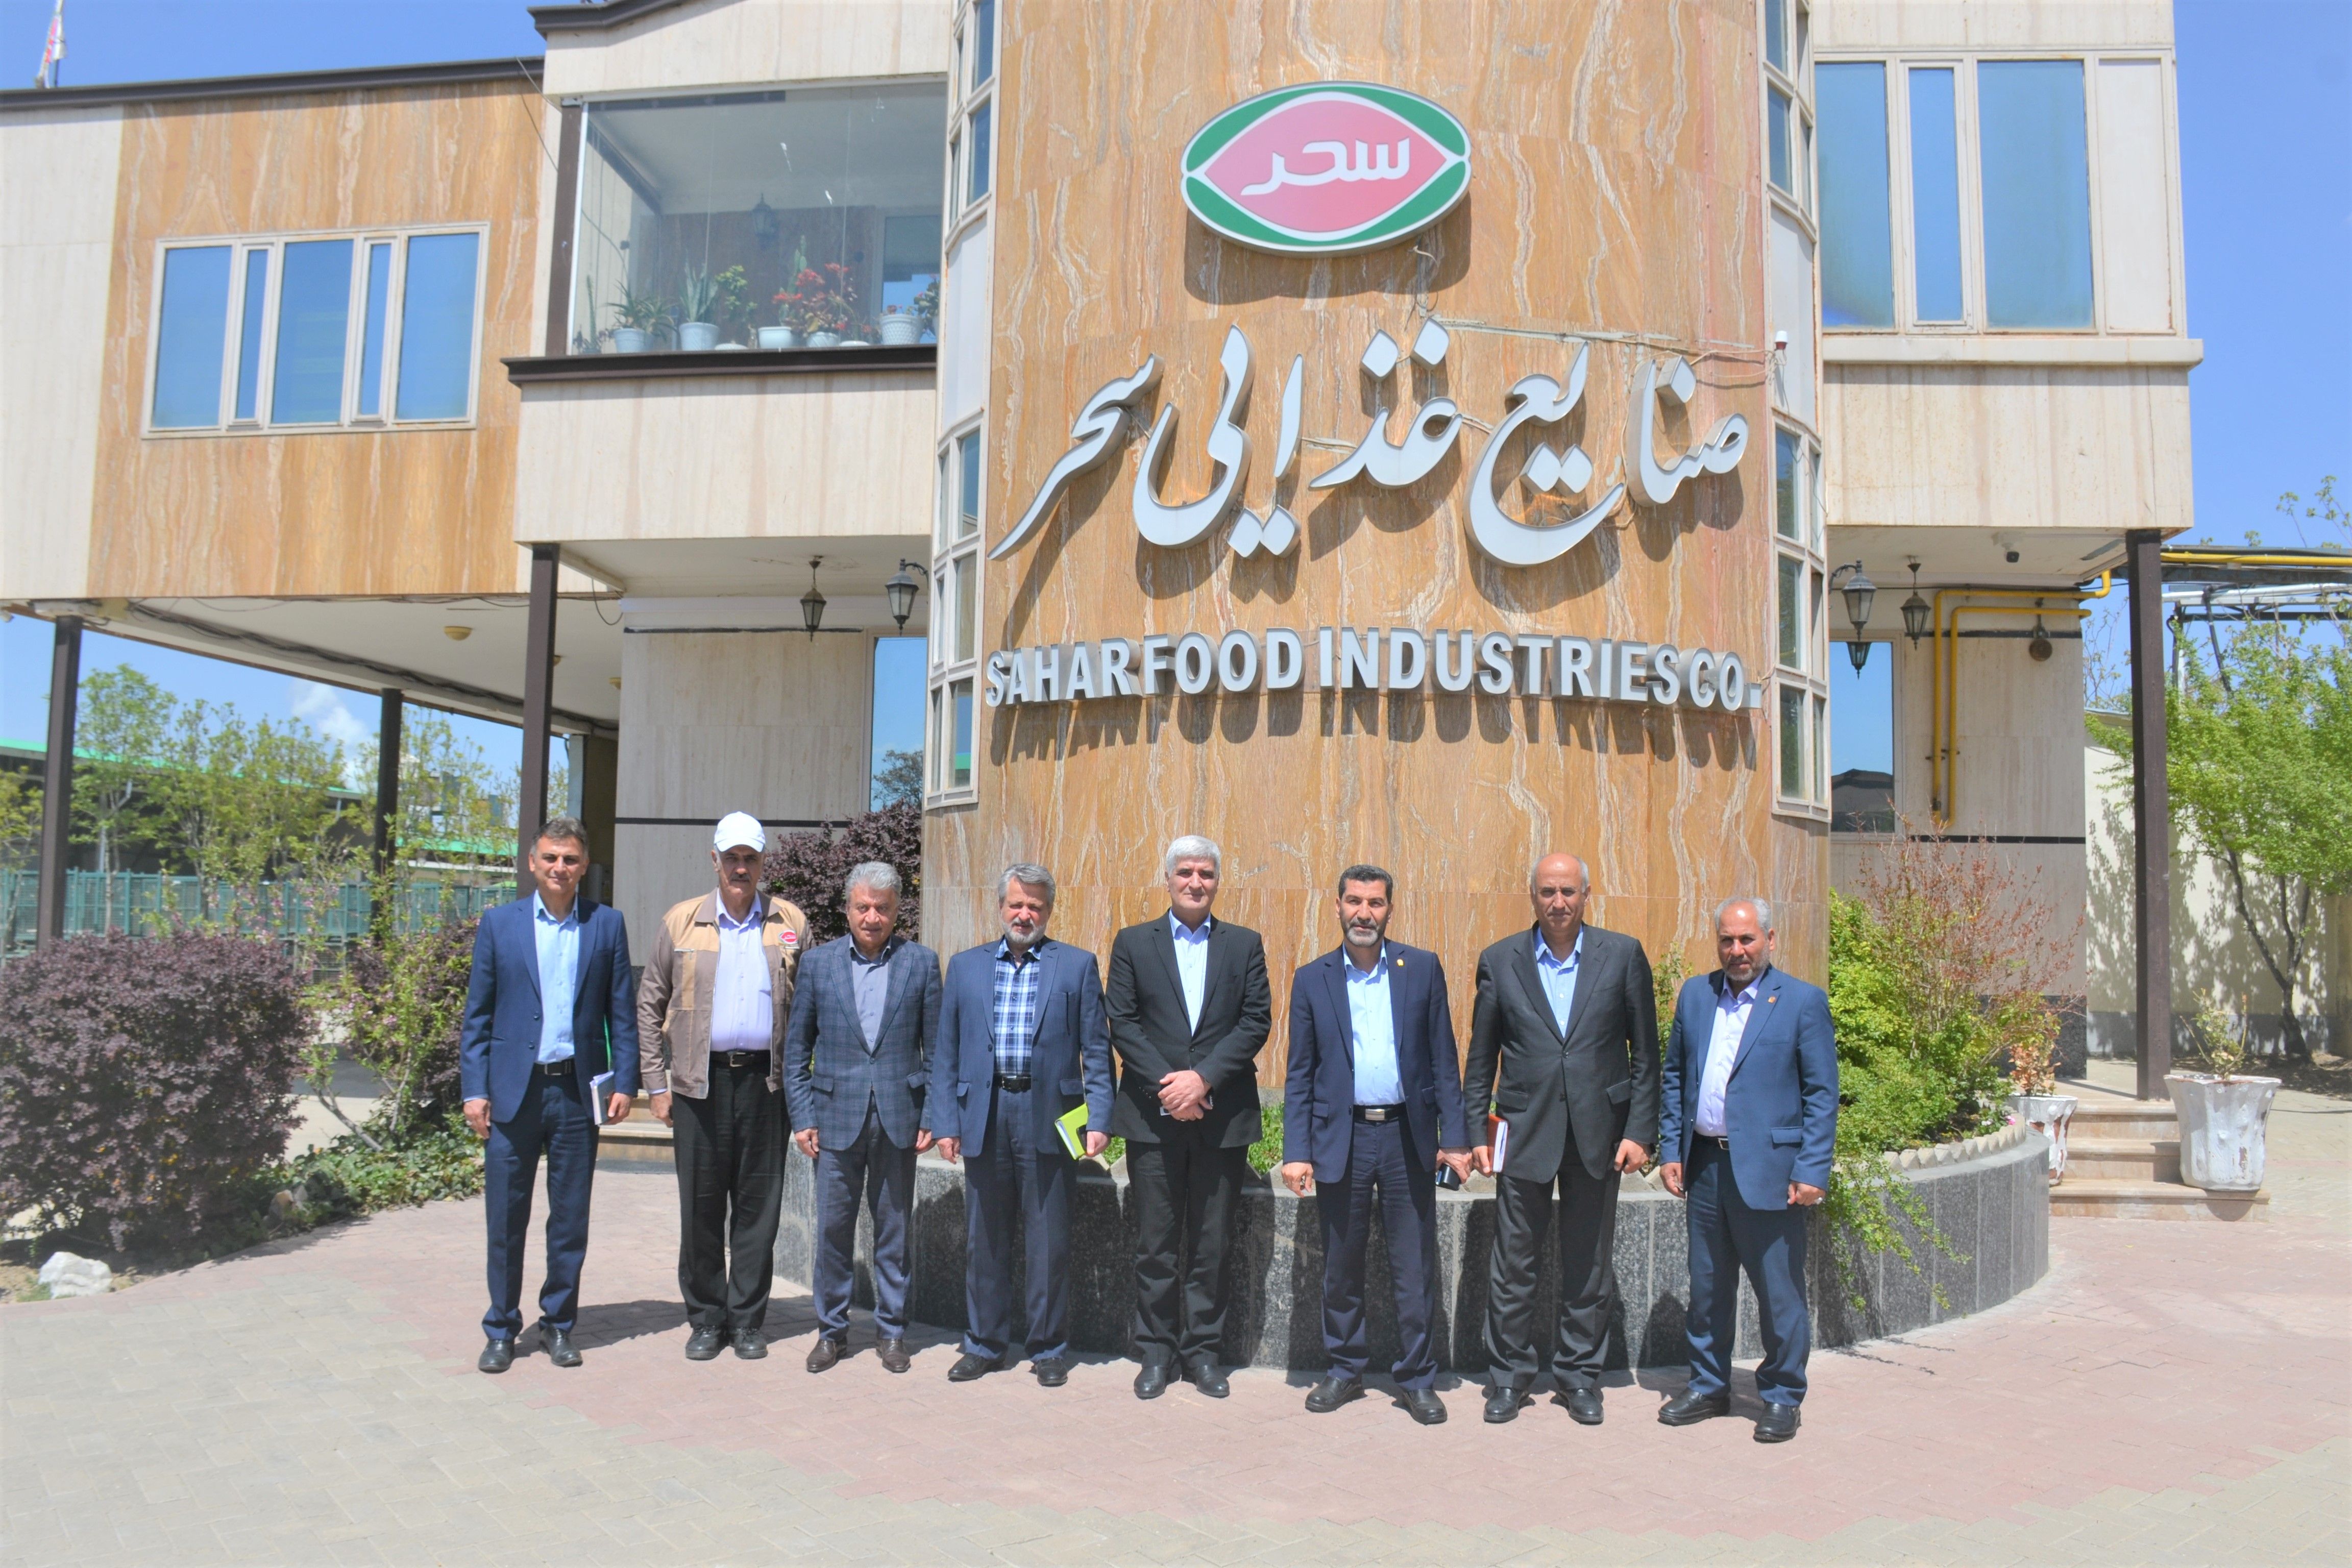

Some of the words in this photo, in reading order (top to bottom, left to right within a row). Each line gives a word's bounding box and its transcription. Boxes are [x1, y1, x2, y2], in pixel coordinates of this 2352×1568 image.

[1240, 137, 1410, 196] سحر
[988, 353, 1164, 561] سحر
[1133, 318, 1463, 559] غذایی
[1465, 340, 1750, 568] صنایع
[986, 638, 1140, 707] SAHAR
[1143, 627, 1305, 695] FOOD
[1320, 626, 1680, 705] INDUSTRIES
[1687, 647, 1762, 711] CO.
